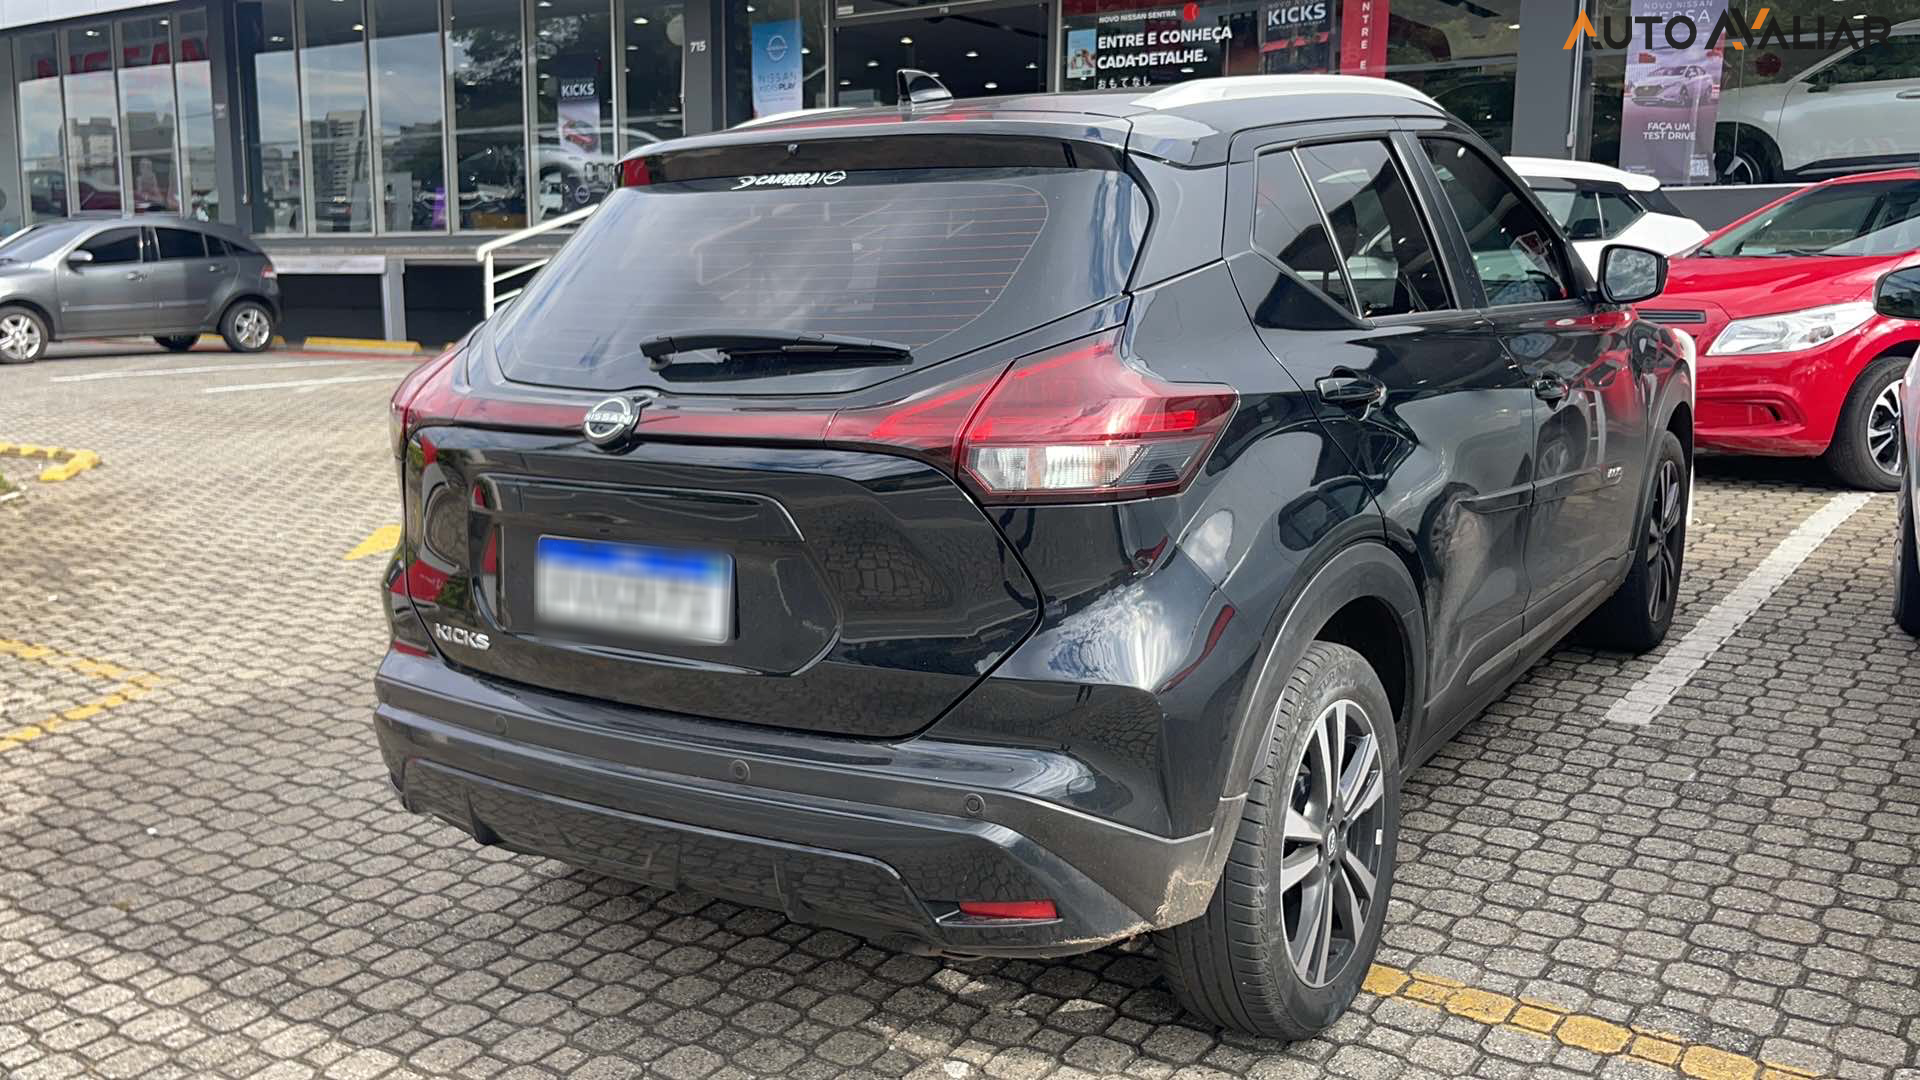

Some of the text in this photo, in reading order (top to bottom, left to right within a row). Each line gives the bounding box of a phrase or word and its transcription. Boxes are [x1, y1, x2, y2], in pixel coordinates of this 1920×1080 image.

[1677, 0, 1713, 8] NISSAN
[1098, 10, 1177, 24] NOVO NISSAN SENTRA
[1267, 3, 1326, 26] KICKS
[1098, 26, 1232, 49] ENTRE E CONHEÇA
[690, 40, 706, 53] 715
[1097, 49, 1208, 69] CADA DETALHE.
[560, 82, 595, 98] KICKS
[1097, 76, 1151, 90] おもてなし
[1647, 122, 1691, 133] FAÇA UM
[1642, 131, 1696, 140] TEST DRIVE
[754, 172, 820, 185] CARRERA
[584, 412, 633, 425] NISSAN
[435, 623, 491, 650] KICKS
